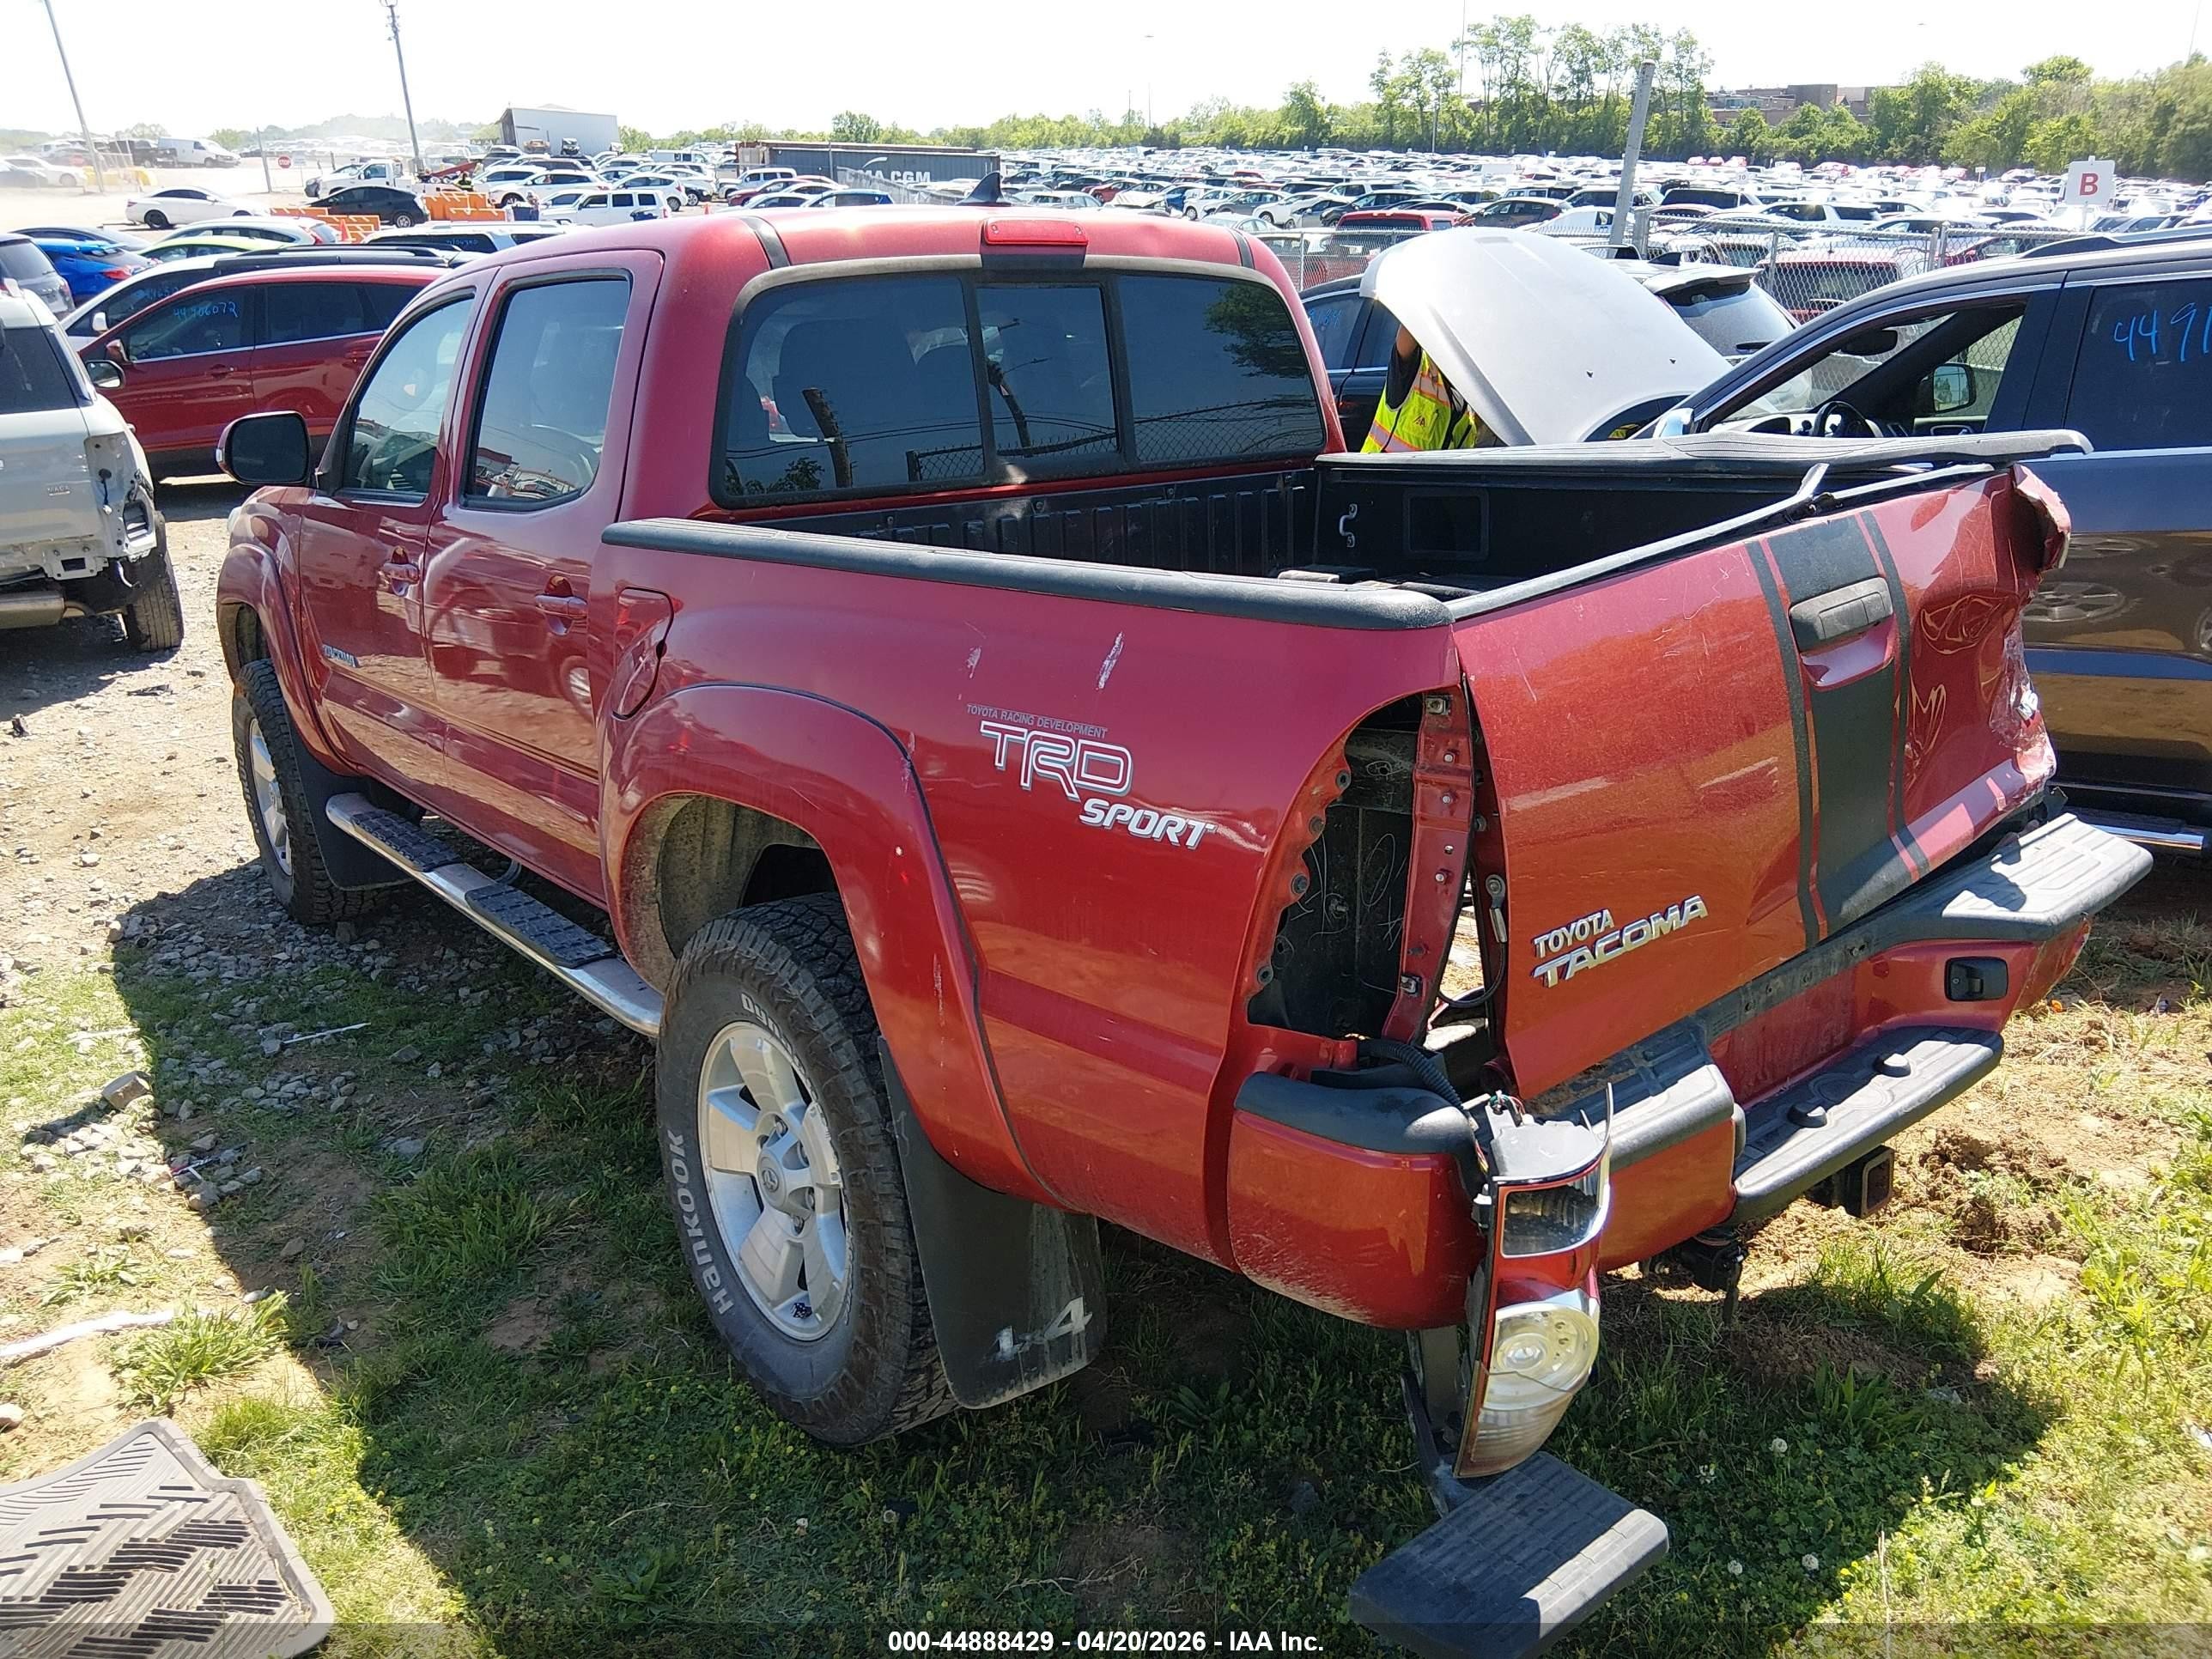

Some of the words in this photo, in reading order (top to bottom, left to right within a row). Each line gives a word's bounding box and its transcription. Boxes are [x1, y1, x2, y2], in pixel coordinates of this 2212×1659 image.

[890, 171, 931, 183] CGM
[2079, 173, 2100, 196] B
[967, 704, 998, 720] TOYOTA
[1000, 710, 1034, 726] RACING
[1036, 717, 1108, 739] DEVELOPMENT
[980, 720, 1133, 801] TRD
[1079, 798, 1218, 848] SPORT
[1532, 894, 1708, 988] TACOMA
[1533, 908, 1614, 958] TOYOTA
[667, 1129, 734, 1316] Hankook
